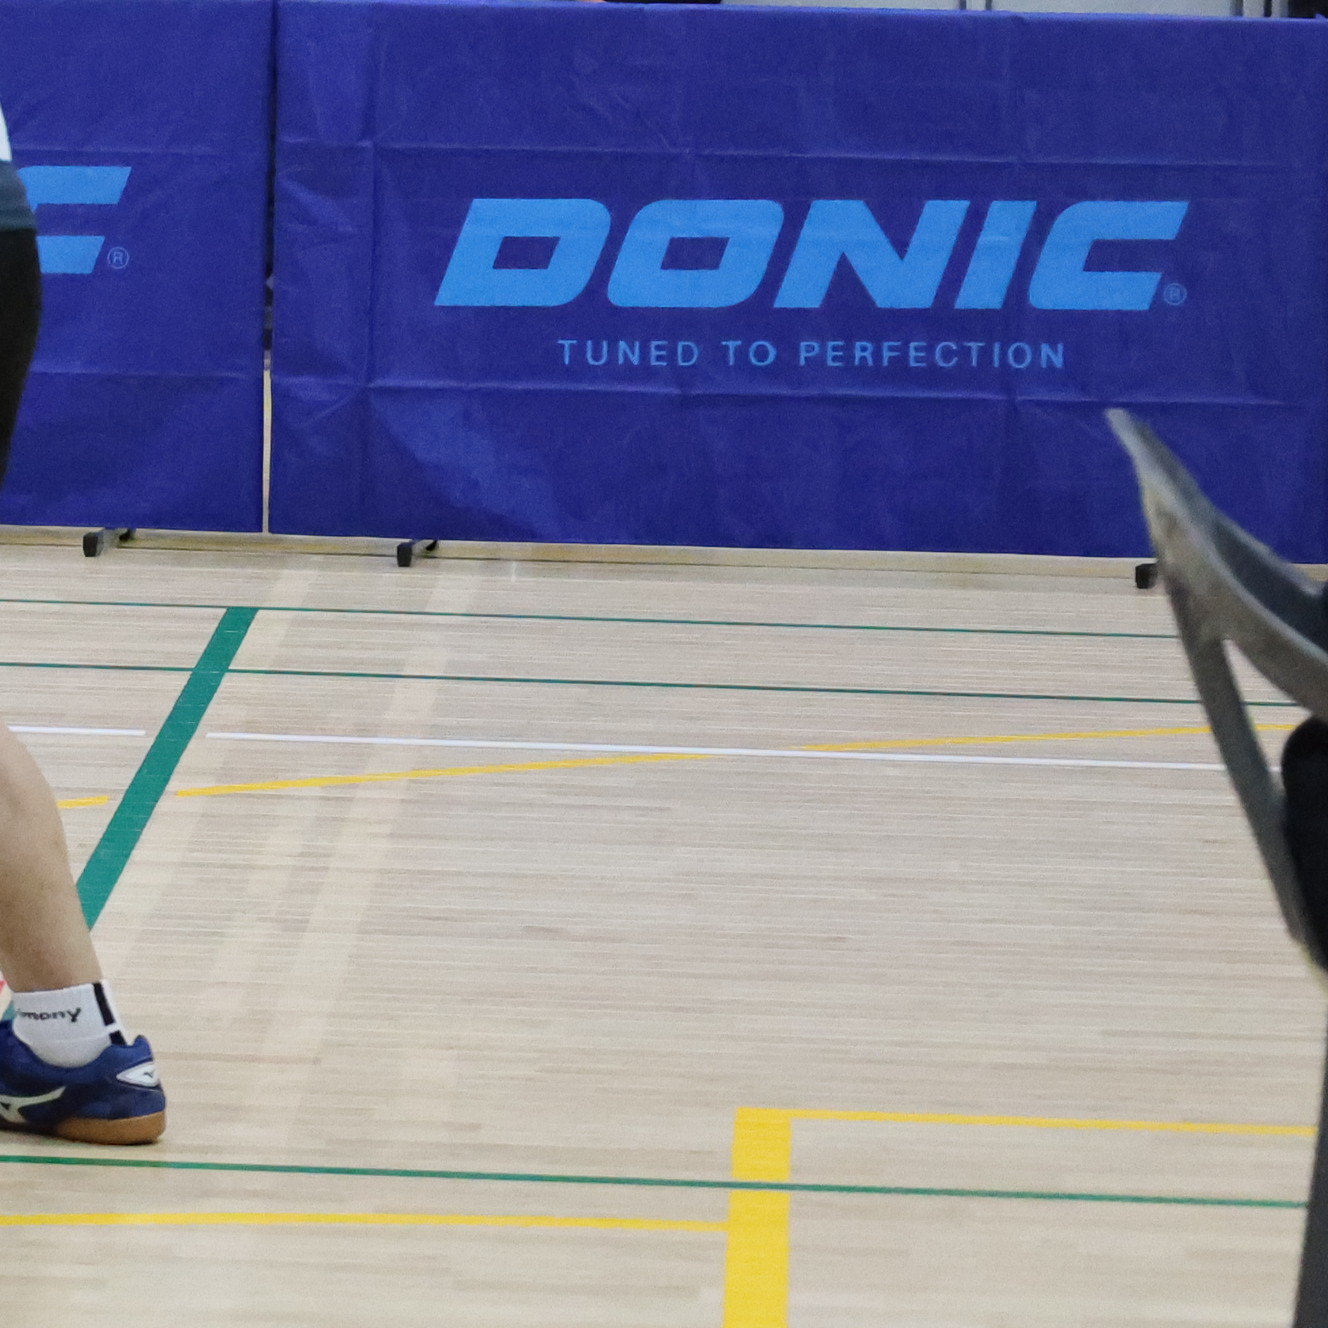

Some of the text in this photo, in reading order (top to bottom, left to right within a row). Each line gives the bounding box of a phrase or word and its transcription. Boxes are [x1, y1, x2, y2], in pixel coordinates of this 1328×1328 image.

[434, 198, 1189, 310] DONIC
[558, 339, 1066, 370] TUNED TO PERFECTION
